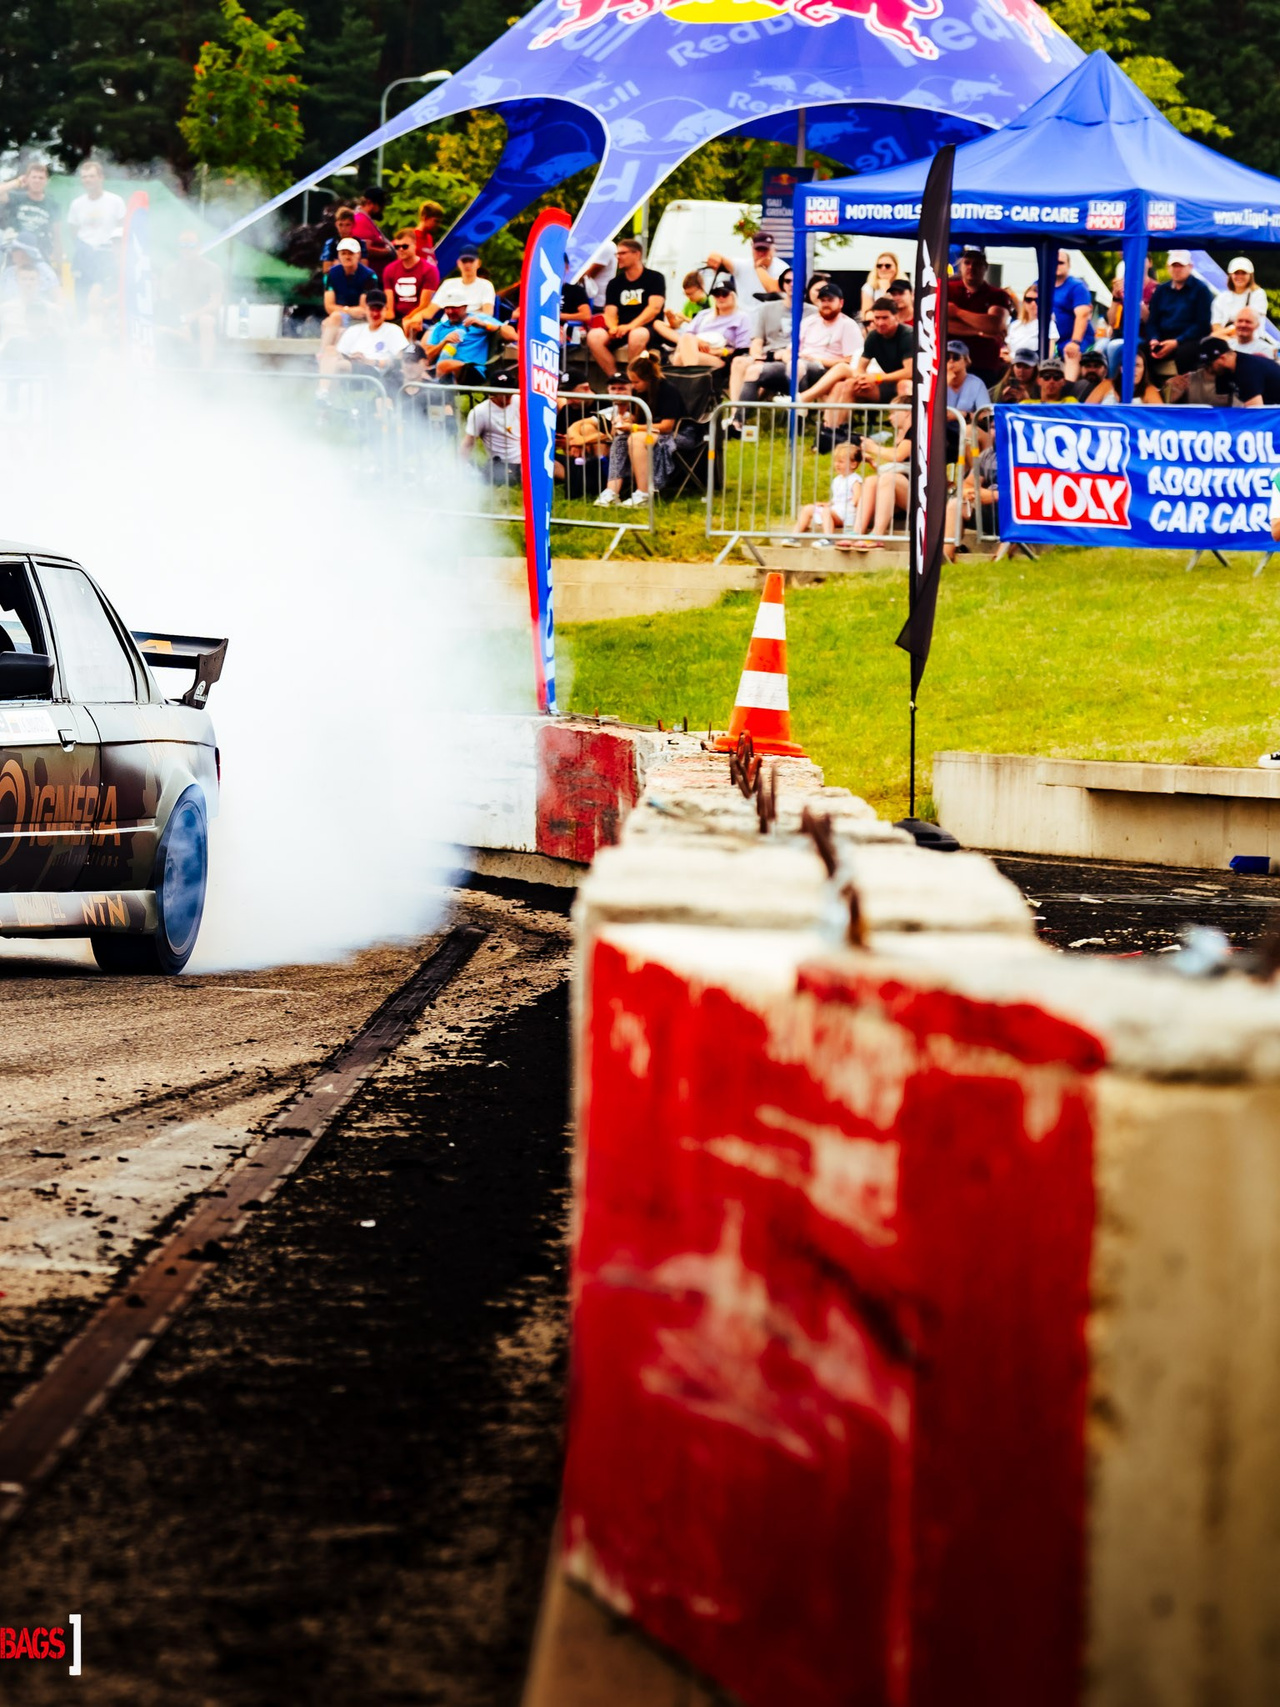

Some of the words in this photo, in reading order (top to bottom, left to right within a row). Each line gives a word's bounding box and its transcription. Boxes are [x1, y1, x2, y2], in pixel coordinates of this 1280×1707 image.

[807, 198, 838, 211] LIQUI
[845, 204, 893, 220] MOTOR
[894, 204, 922, 220] OILS
[950, 204, 1003, 220] DITIVES
[1010, 205, 1040, 222] CAR
[1041, 207, 1079, 223] CARE
[1089, 202, 1125, 216] LIQUI
[806, 211, 838, 225] MOLY
[1088, 215, 1124, 229] MOLY
[620, 288, 645, 306] CAT
[1012, 420, 1123, 473] LIQUI
[1137, 429, 1235, 463] MOTOR
[1147, 465, 1278, 499] ADDITIVE
[1017, 471, 1127, 521] MOLY
[1148, 500, 1210, 533] CAR
[1211, 502, 1272, 534] CAR
[28, 784, 120, 847] IGNERA
